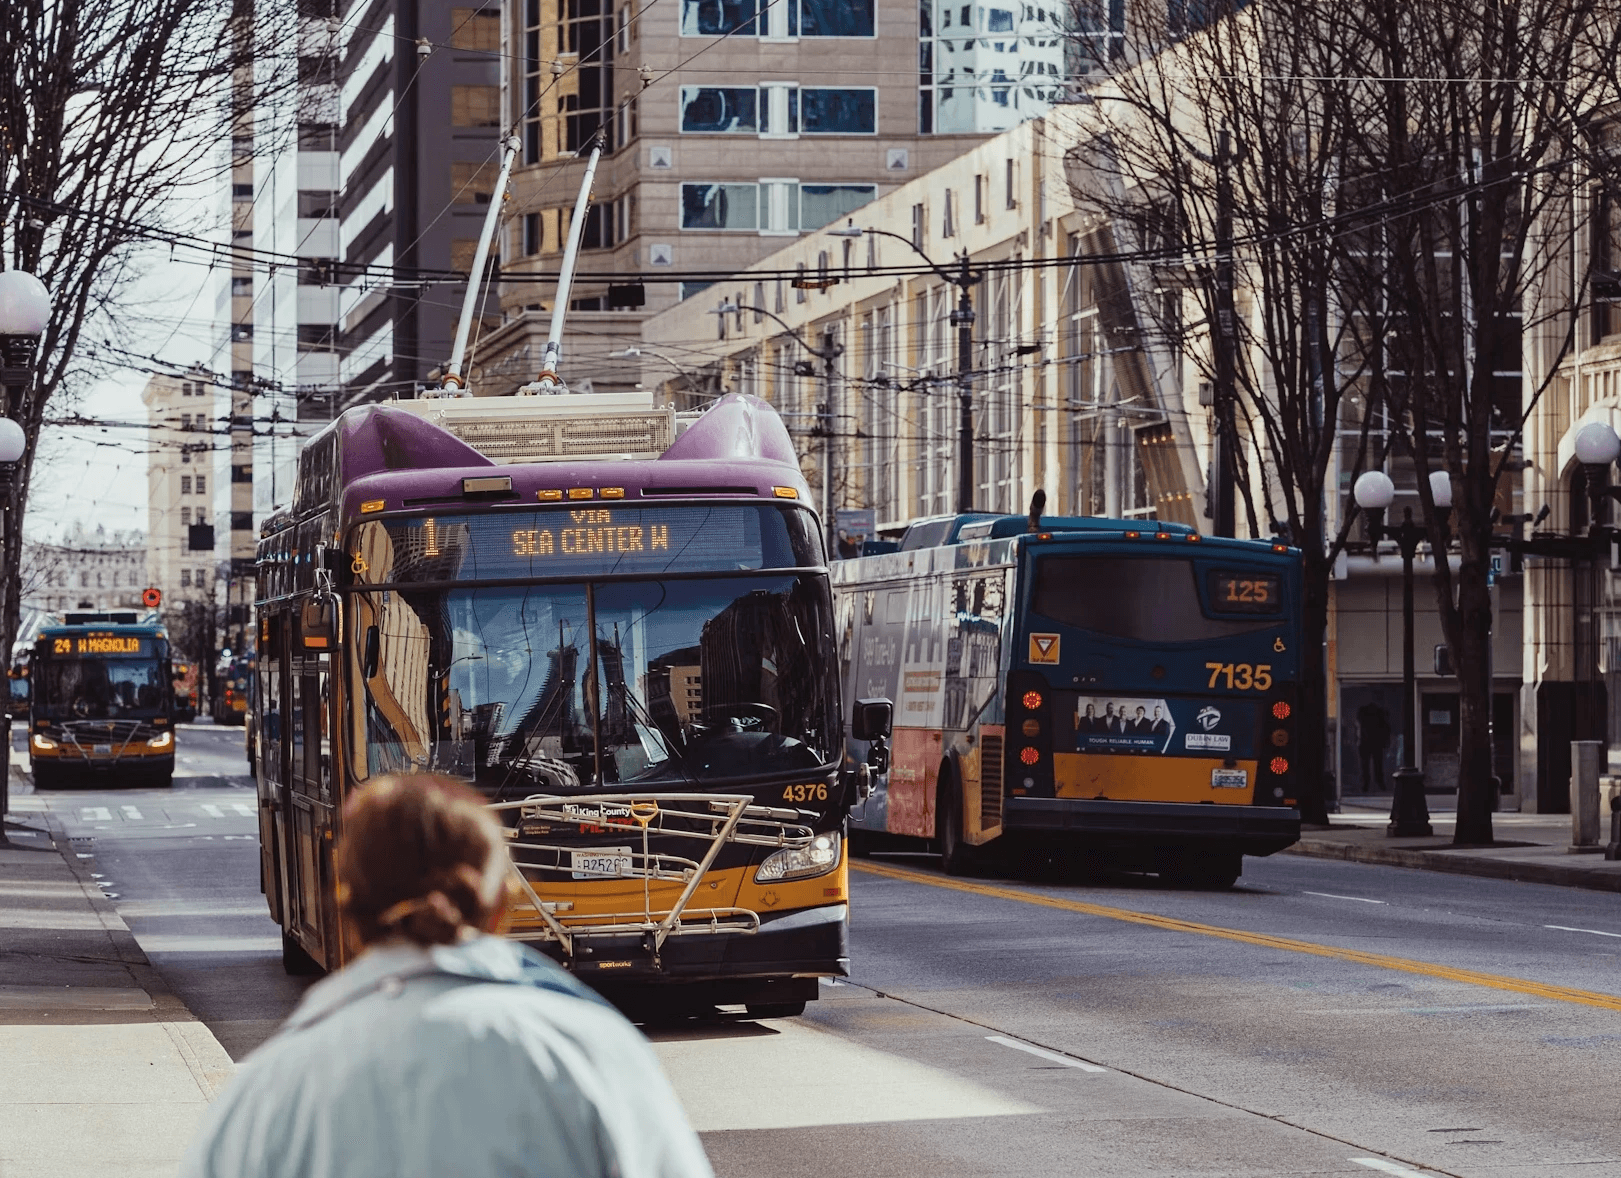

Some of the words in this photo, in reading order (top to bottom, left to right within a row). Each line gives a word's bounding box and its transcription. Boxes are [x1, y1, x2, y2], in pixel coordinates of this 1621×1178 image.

[424, 518, 439, 556] 1
[513, 530, 553, 555] SEA
[561, 526, 643, 553] CENTER
[651, 525, 668, 550] W
[1227, 580, 1269, 602] 125
[54, 639, 71, 654] 24
[88, 638, 140, 653] MAGNOLIA
[1205, 662, 1272, 691] 7135
[1213, 735, 1229, 743] LAW
[782, 783, 828, 802] 4376
[579, 808, 600, 818] King
[601, 806, 631, 818] County
[599, 961, 632, 969] sportworks
